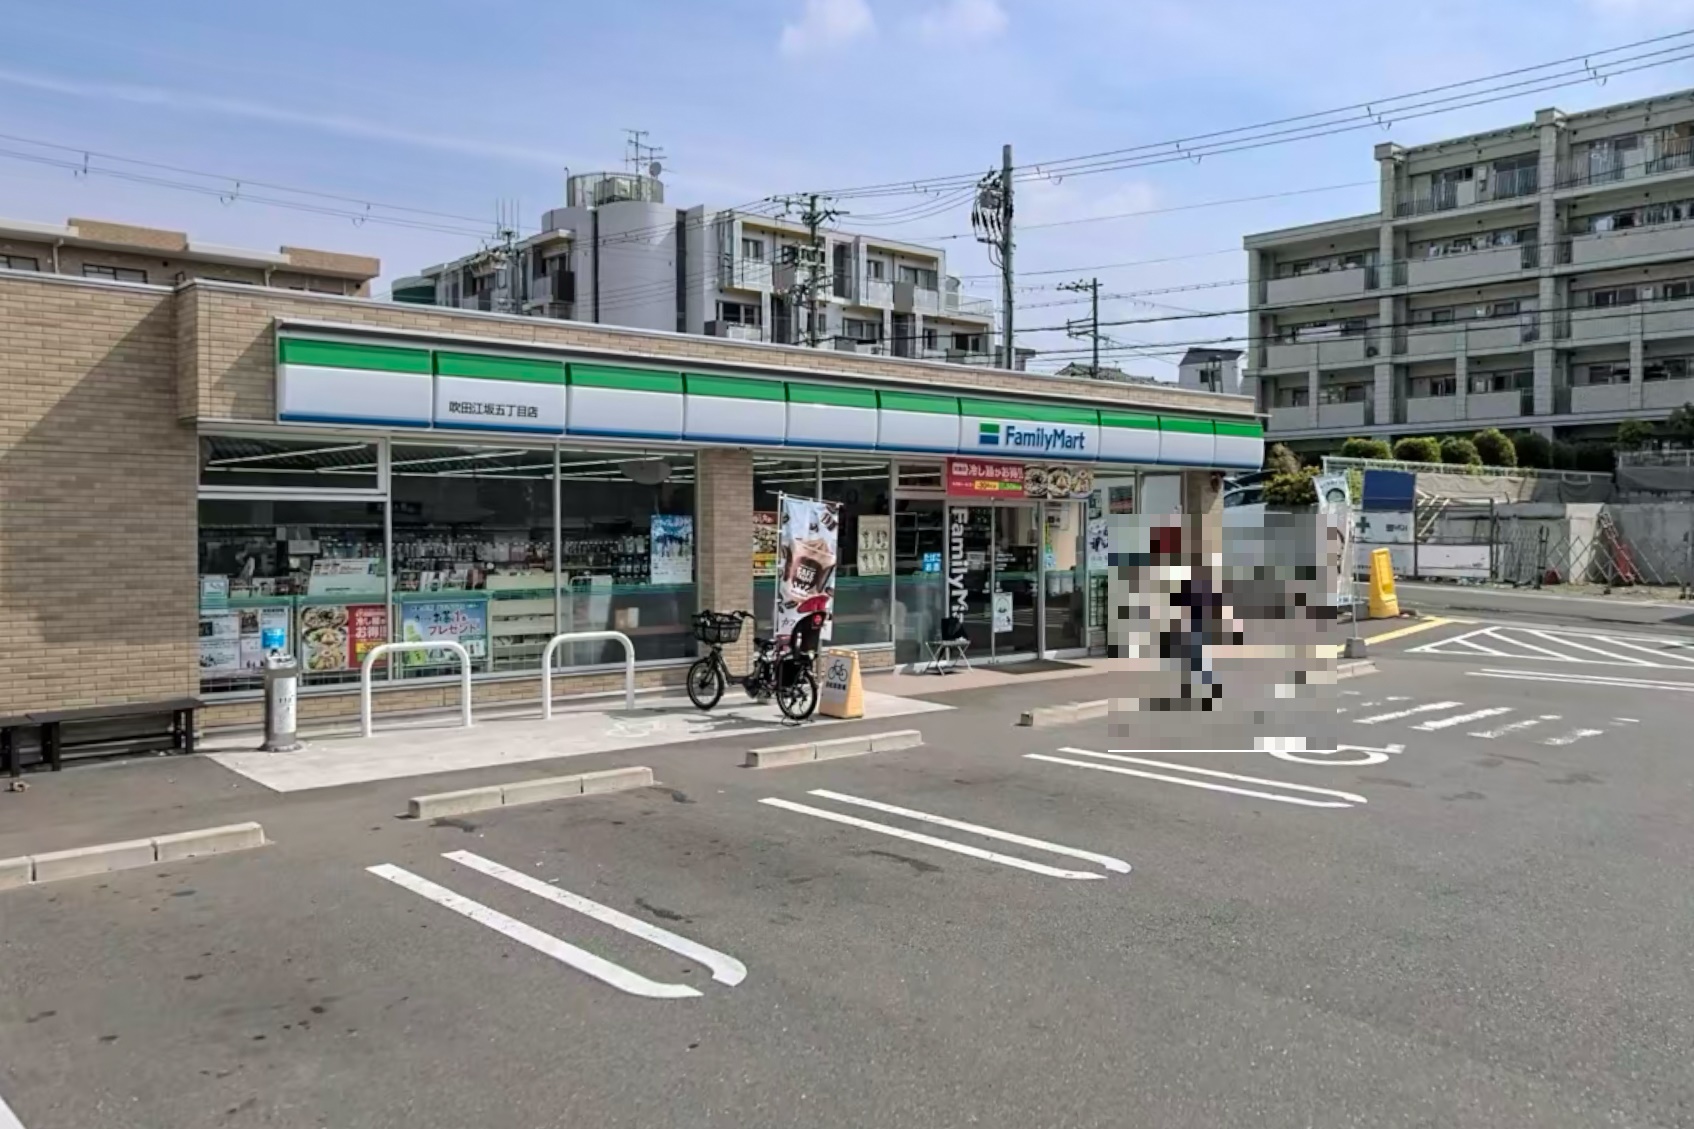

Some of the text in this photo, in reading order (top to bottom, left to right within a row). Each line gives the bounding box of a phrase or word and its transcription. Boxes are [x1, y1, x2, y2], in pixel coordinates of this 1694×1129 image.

[448, 400, 539, 418] 吹田江坂五丁目店
[1005, 425, 1086, 450] FamilyMart
[947, 508, 968, 623] FamilyM
